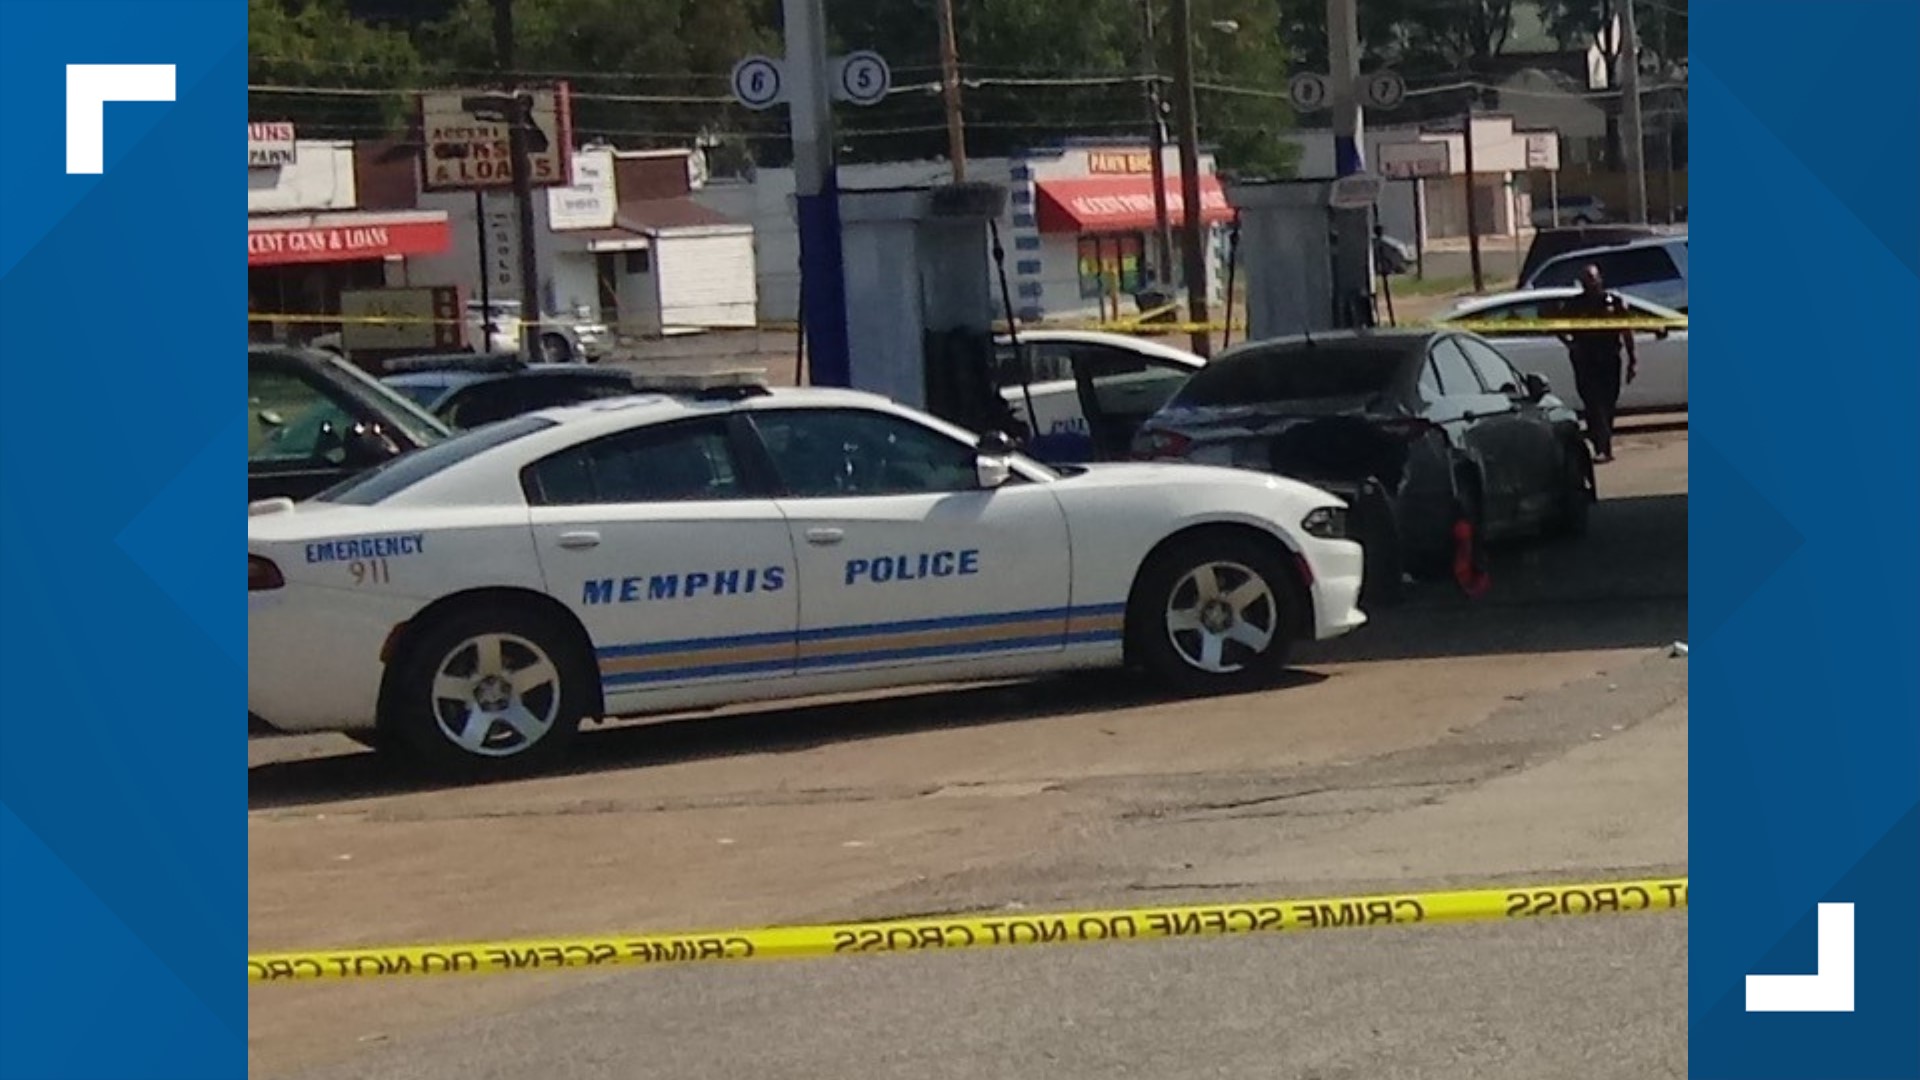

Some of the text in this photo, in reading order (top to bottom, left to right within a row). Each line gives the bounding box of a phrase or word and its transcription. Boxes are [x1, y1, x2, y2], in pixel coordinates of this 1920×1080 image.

[752, 71, 764, 92] 6
[857, 68, 871, 88] 5
[1381, 81, 1390, 98] 7
[460, 158, 552, 181] LOAS
[288, 231, 326, 251] GUNS
[329, 229, 342, 249] &
[344, 227, 389, 249] LOANS
[306, 534, 423, 563] EMERGENCY
[350, 558, 390, 585] 911
[582, 549, 979, 605] MEMPHIS POLICE
